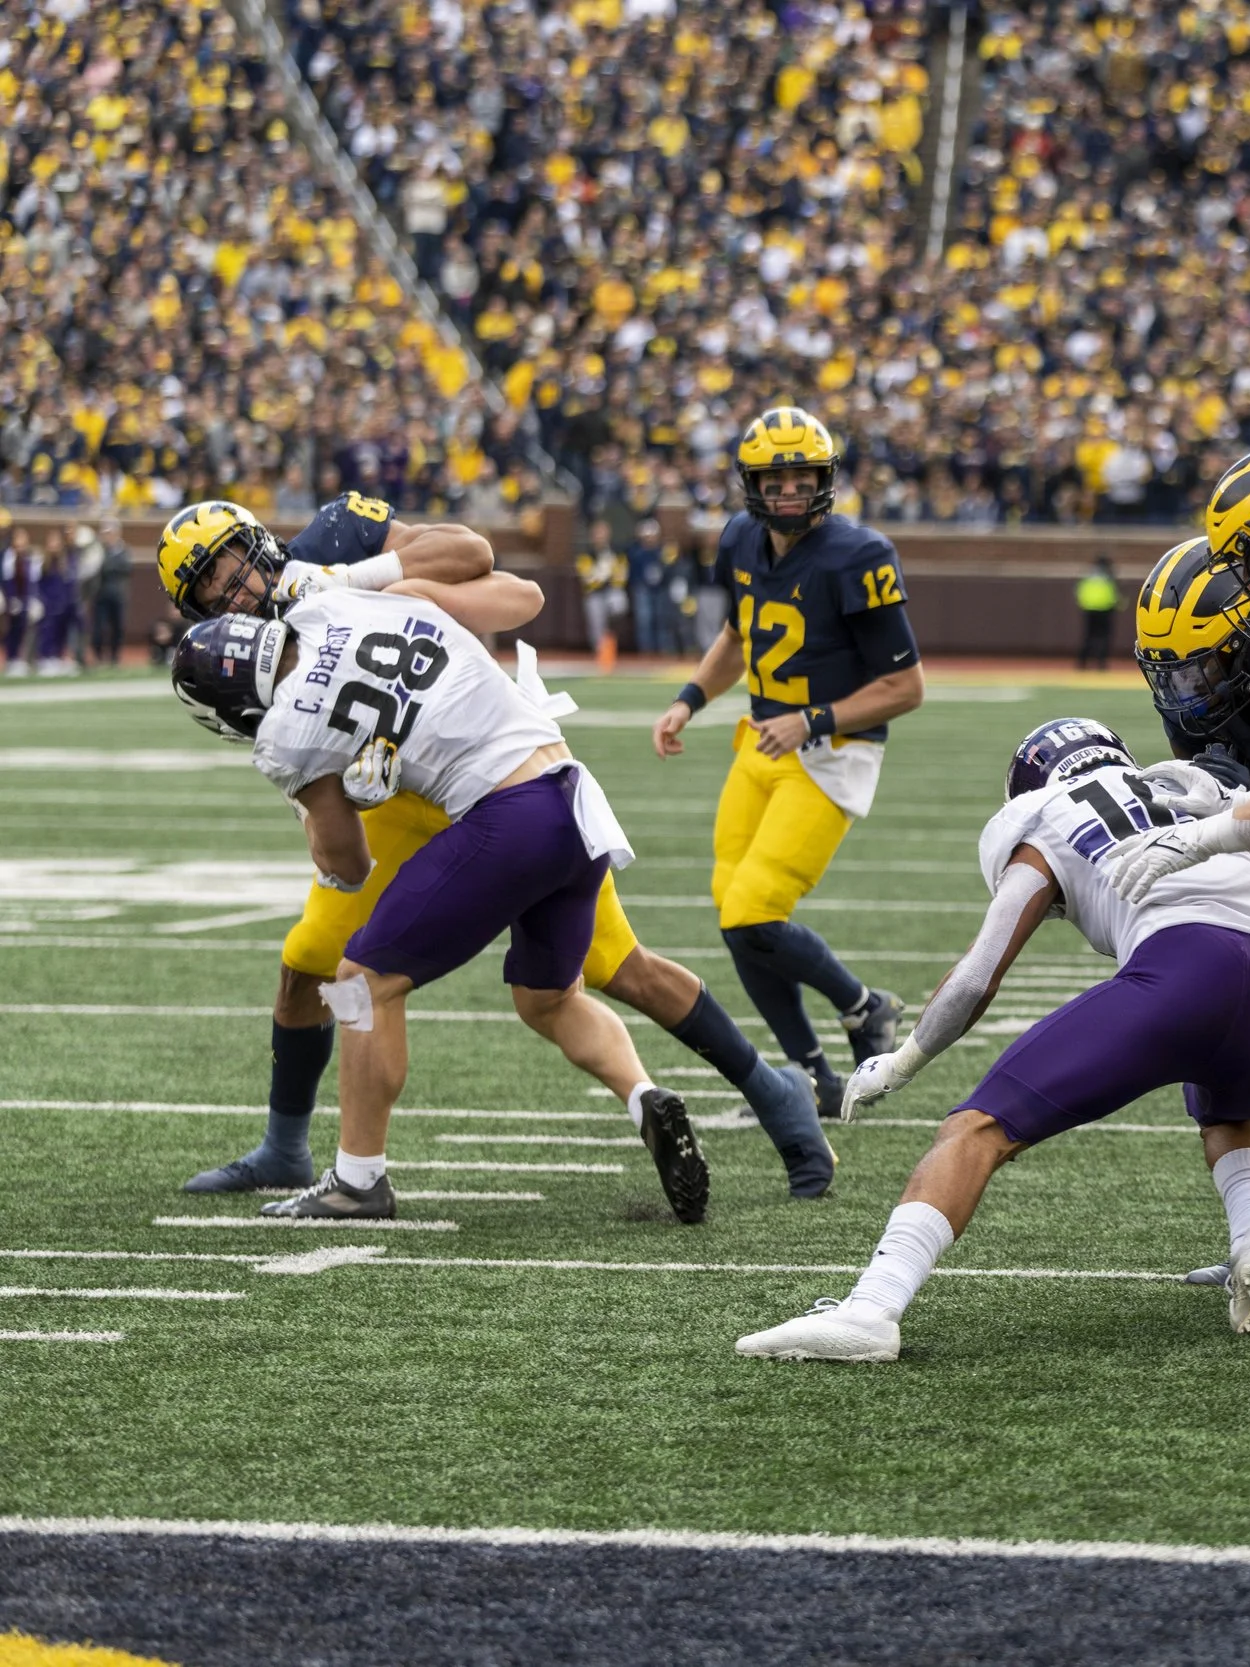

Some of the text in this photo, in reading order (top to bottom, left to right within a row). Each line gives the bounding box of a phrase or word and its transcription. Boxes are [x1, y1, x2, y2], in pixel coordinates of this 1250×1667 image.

[183, 552, 197, 568] M
[863, 563, 903, 609] 12
[224, 624, 257, 660] 28
[260, 627, 281, 674] WILDCATS
[738, 594, 811, 706] 12
[1149, 650, 1162, 661] M
[294, 697, 324, 714] C.
[327, 631, 450, 757] 28
[1044, 722, 1085, 749] 16
[1057, 746, 1104, 773] WILDCATS
